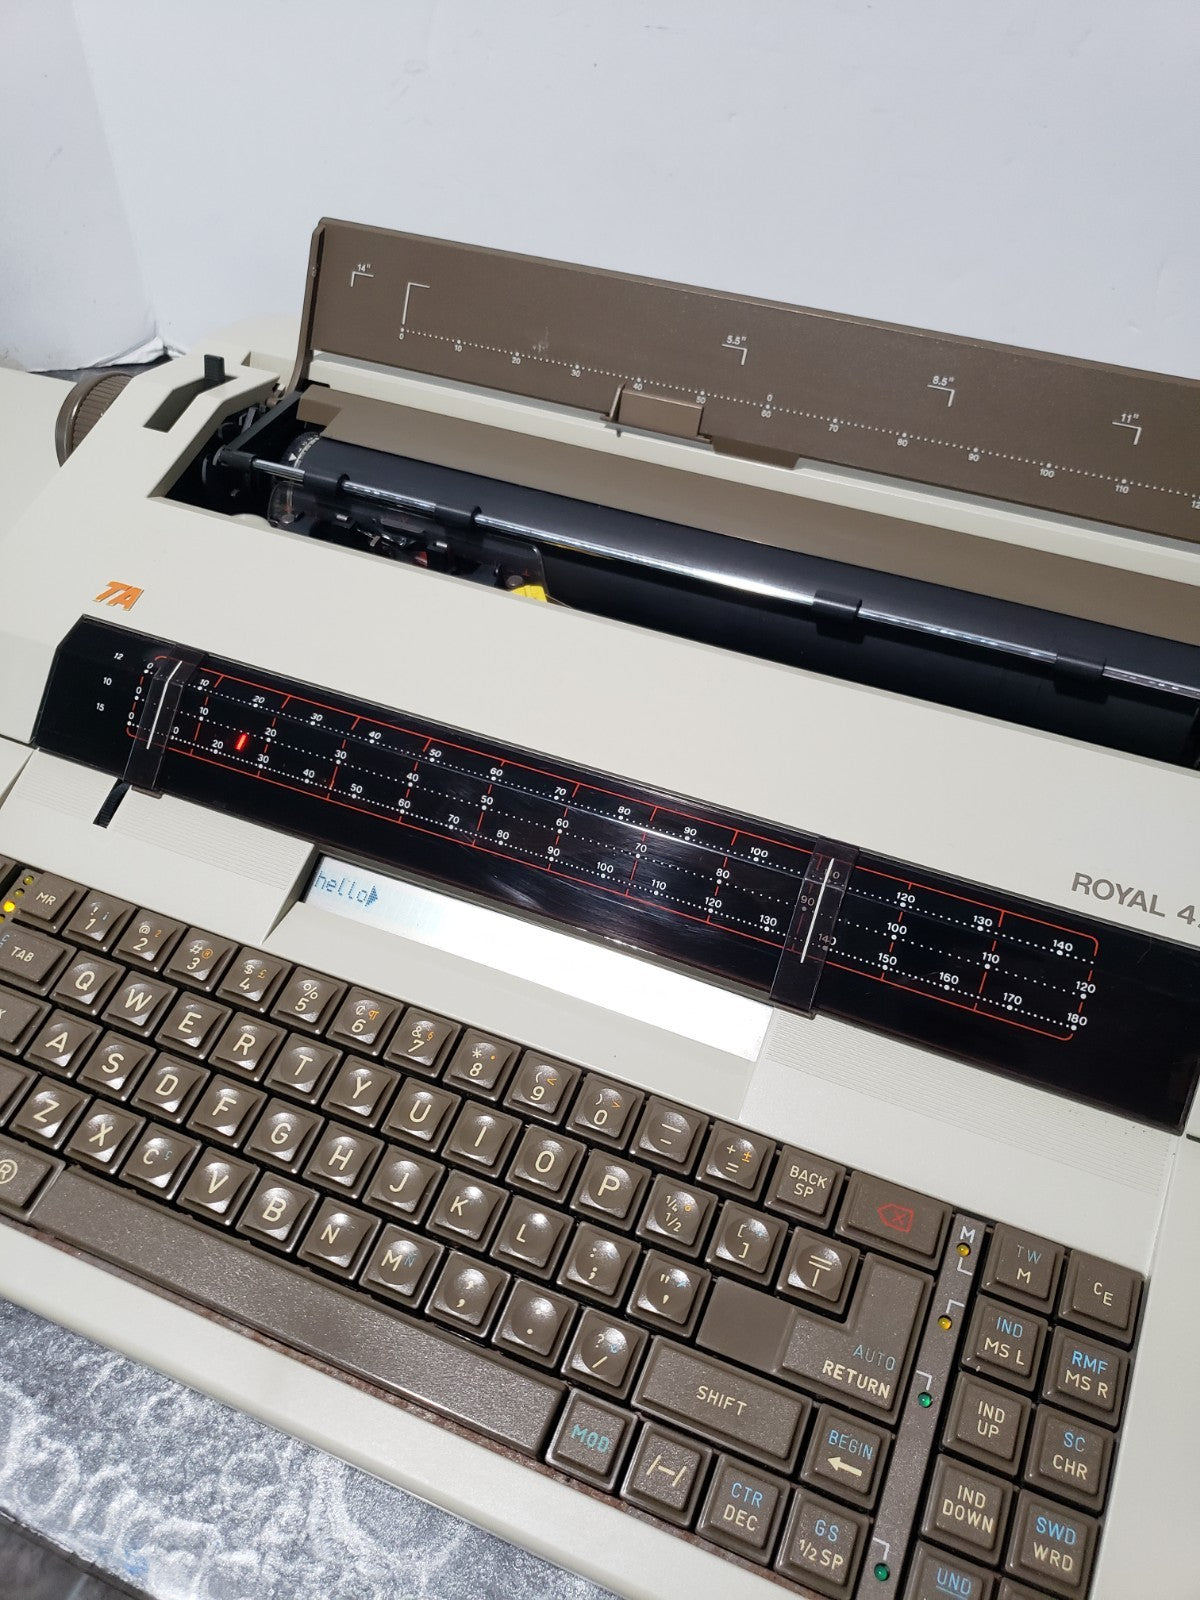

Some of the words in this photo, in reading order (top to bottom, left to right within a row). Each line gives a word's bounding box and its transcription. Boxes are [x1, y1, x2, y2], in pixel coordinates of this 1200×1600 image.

[454, 344, 462, 352] 10
[512, 356, 521, 365] 20
[571, 369, 581, 378] 30
[632, 382, 643, 391] 40
[761, 409, 772, 418] 60
[828, 424, 839, 432] 70
[897, 438, 908, 447] 80
[968, 452, 980, 462] 90
[1039, 468, 1055, 478] 100
[1115, 484, 1130, 494] 110
[92, 580, 144, 612] TA
[114, 652, 124, 661] 12
[146, 662, 154, 670] 0
[102, 676, 112, 686] 10
[199, 678, 210, 686] 10
[136, 686, 142, 694] 0
[96, 702, 105, 712] 15
[252, 696, 265, 704] 20
[128, 712, 135, 720] 0
[199, 706, 209, 716] 10
[310, 712, 323, 722] 30
[264, 728, 277, 738] 20
[368, 731, 382, 740] 40
[212, 740, 224, 750] 20
[257, 754, 270, 764] 30
[334, 750, 347, 760] 30
[428, 748, 442, 758] 50
[302, 768, 316, 778] 40
[406, 772, 420, 782] 40
[490, 767, 503, 777] 60
[350, 784, 363, 794] 50
[554, 787, 566, 796] 70
[398, 798, 411, 809] 60
[480, 795, 494, 806] 50
[617, 806, 631, 816] 80
[448, 814, 460, 825] 70
[556, 818, 570, 830] 60
[496, 830, 510, 840] 80
[684, 826, 697, 837] 90
[547, 846, 560, 857] 90
[635, 842, 648, 854] 70
[750, 846, 768, 858] 100
[596, 862, 614, 874] 100
[716, 868, 730, 880] 80
[314, 870, 368, 904] hello
[650, 880, 667, 891] 110
[36, 892, 57, 906] MR
[704, 896, 722, 909] 120
[801, 896, 815, 906] 90
[896, 892, 916, 904] 120
[1071, 872, 1166, 918] ROYAL
[1176, 904, 1200, 928] 4
[85, 918, 96, 930] 1
[758, 914, 778, 927] 130
[972, 915, 993, 927] 130
[887, 922, 908, 935] 100
[132, 938, 148, 950] 2
[1052, 940, 1074, 952] 140
[10, 946, 35, 962] TAB
[878, 953, 898, 966] 150
[982, 952, 1000, 964] 110
[186, 957, 200, 970] 3
[74, 970, 96, 991] Q
[239, 978, 250, 990] 4
[939, 972, 960, 986] 160
[303, 982, 319, 1000] %
[1075, 980, 1096, 994] 120
[124, 988, 152, 1012] W
[294, 998, 310, 1012] 5
[1003, 992, 1022, 1006] 170
[178, 1012, 202, 1034] E
[351, 1018, 367, 1033] 6
[1066, 1012, 1088, 1026] 180
[45, 1032, 69, 1053] A
[232, 1033, 256, 1056] R
[408, 1039, 425, 1053] 7
[101, 1052, 124, 1074] S
[294, 1054, 314, 1076] T
[469, 1062, 483, 1077] 8
[154, 1074, 180, 1096] D
[352, 1076, 372, 1100] Y
[530, 1085, 545, 1101] 9
[33, 1098, 60, 1124] Z
[212, 1096, 237, 1116] F
[409, 1100, 432, 1123] U
[88, 1122, 114, 1147] X
[270, 1122, 292, 1145] G
[474, 1126, 487, 1148] I
[142, 1148, 160, 1166] C
[328, 1144, 354, 1171] H
[534, 1150, 555, 1174] O
[208, 1170, 230, 1194] V
[388, 1172, 410, 1193] J
[789, 1164, 828, 1190] BACK
[598, 1174, 620, 1197] P
[794, 1183, 814, 1198] SP
[262, 1196, 287, 1222] B
[450, 1196, 469, 1217] K
[665, 1212, 682, 1232] 1/2
[320, 1223, 341, 1244] N
[516, 1223, 526, 1244] L
[960, 1226, 976, 1244] M
[380, 1249, 404, 1272] M
[1016, 1268, 1032, 1284] M
[996, 1316, 1024, 1339] IND
[852, 1344, 896, 1372] AUTO
[984, 1337, 1010, 1358] MS
[1015, 1349, 1025, 1366] L
[1071, 1350, 1109, 1375] RMF
[822, 1359, 891, 1400] RETURN
[1064, 1370, 1092, 1392] MS
[1097, 1381, 1109, 1399] R
[696, 1384, 748, 1416] SHIFT
[978, 1400, 1006, 1424] IND
[977, 1421, 1000, 1439] UP
[570, 1424, 610, 1454] MOD
[828, 1429, 874, 1460] BEGIN
[1063, 1432, 1086, 1453] SC
[1052, 1454, 1088, 1480] CHR
[730, 1482, 764, 1508] CTR
[957, 1484, 986, 1510] IND
[722, 1504, 758, 1532] DEC
[942, 1498, 994, 1534] DOWN
[814, 1520, 840, 1542] GS
[1036, 1516, 1076, 1546] SWD
[820, 1548, 844, 1570] SP
[1032, 1542, 1074, 1572] WRD
[936, 1567, 973, 1596] UND
